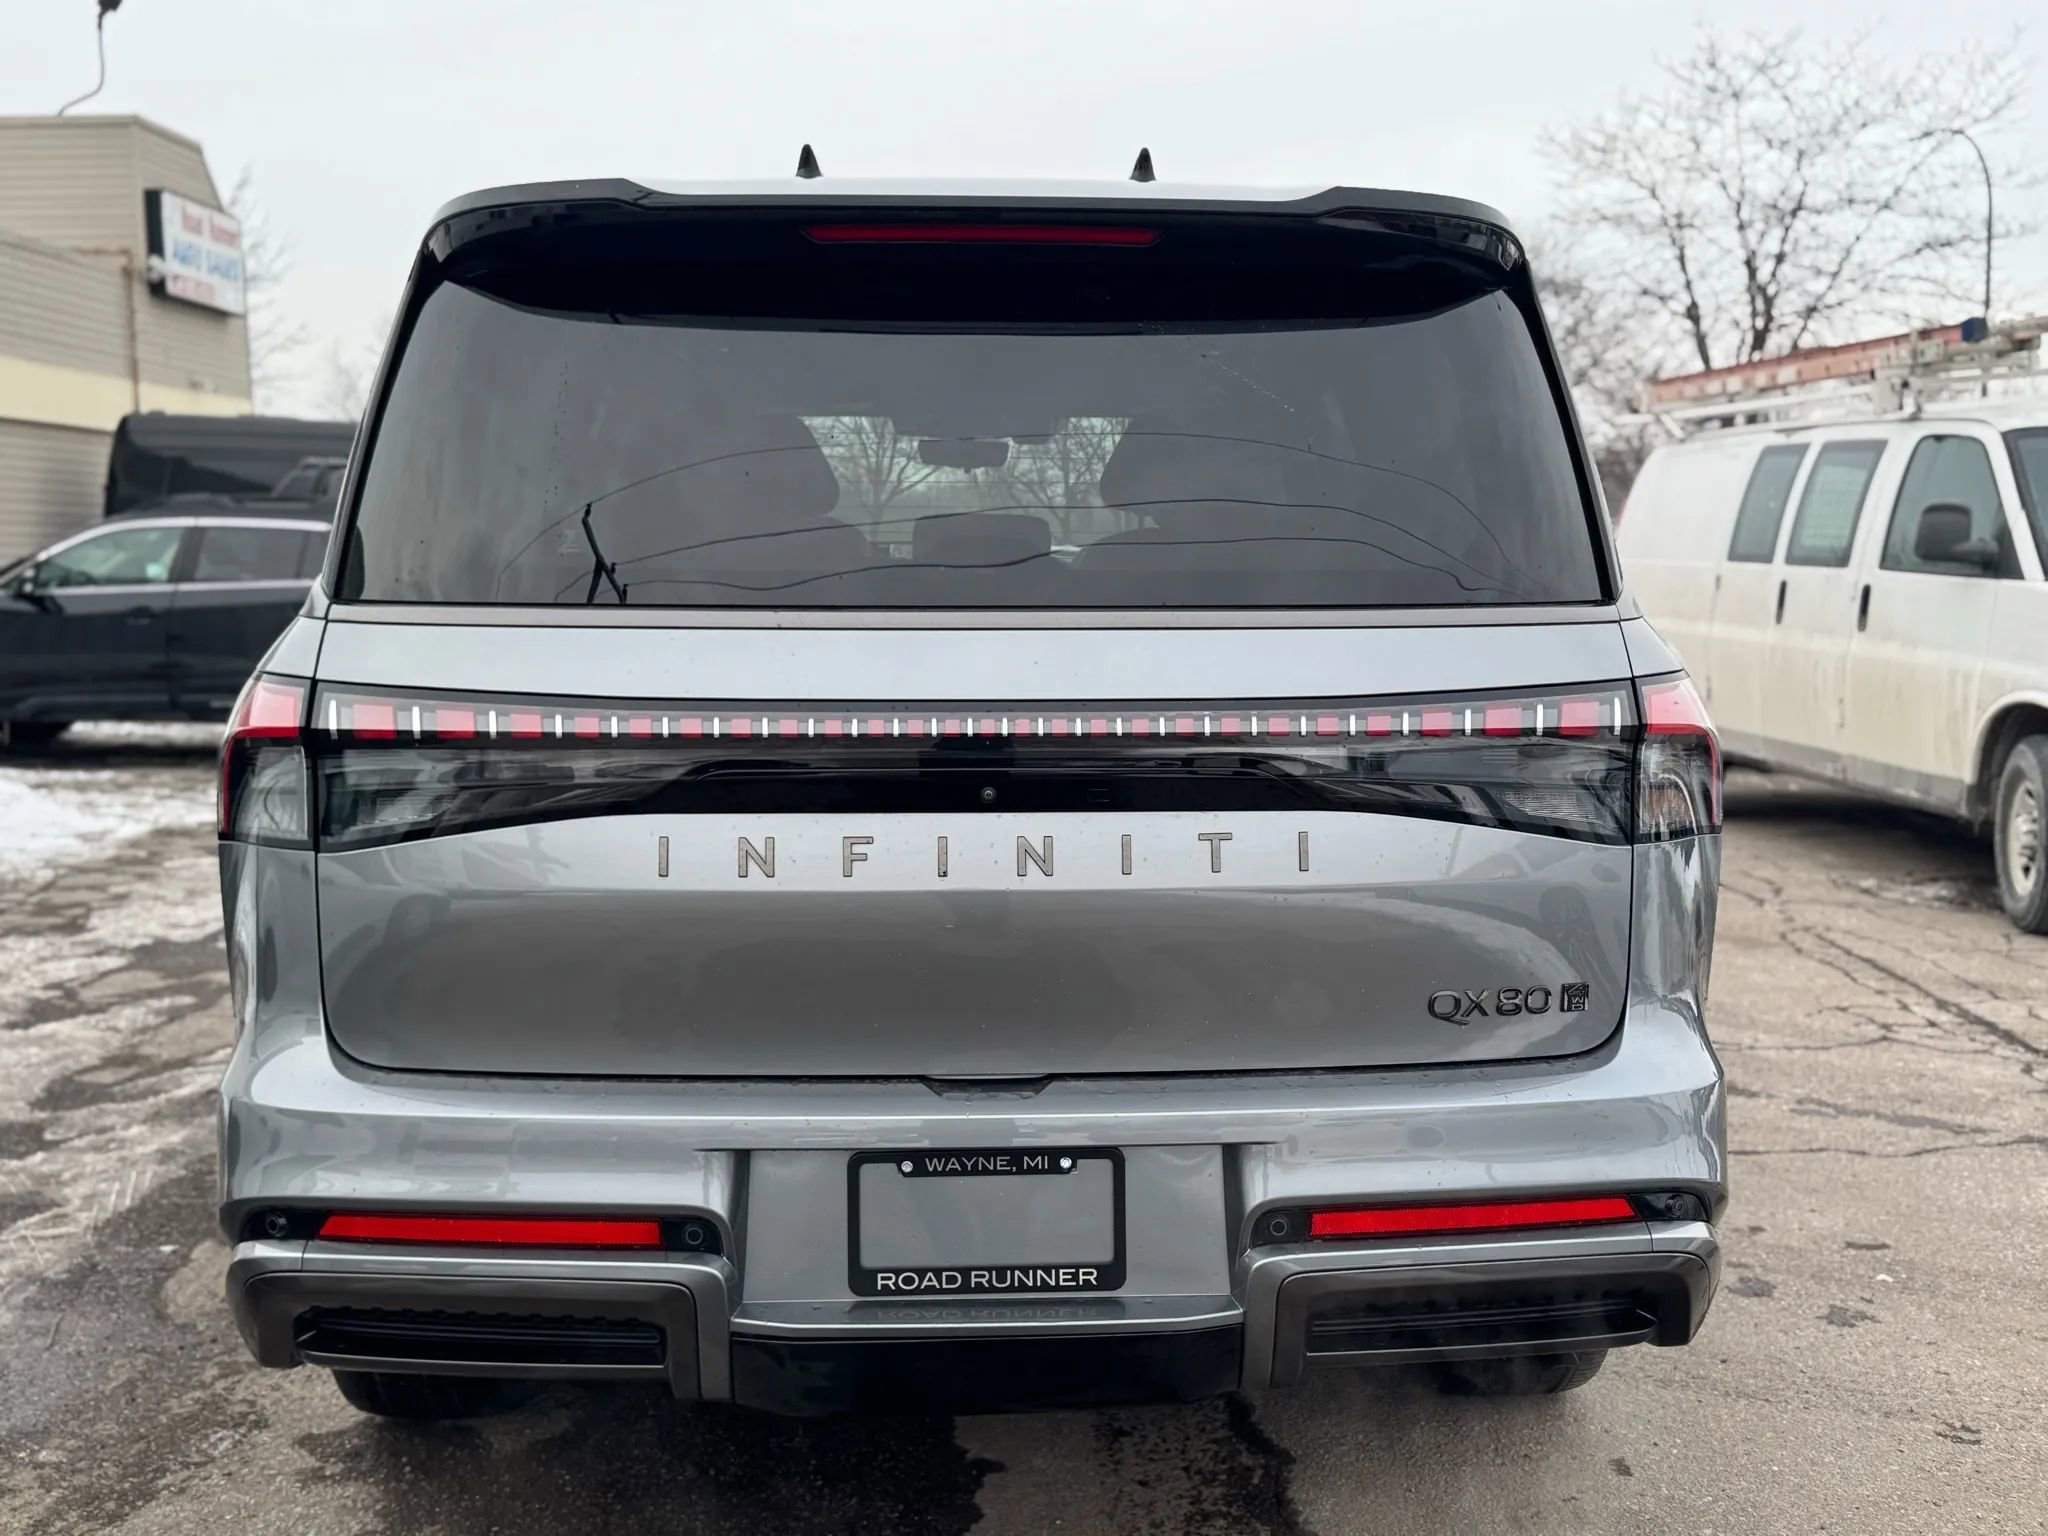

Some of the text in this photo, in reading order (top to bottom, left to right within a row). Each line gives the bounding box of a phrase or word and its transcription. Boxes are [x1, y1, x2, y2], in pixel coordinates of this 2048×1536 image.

[658, 831, 1310, 878] INFINITI
[925, 1156, 1049, 1172] WAYNE, MI
[877, 1268, 1098, 1290] ROAD RUNNER
